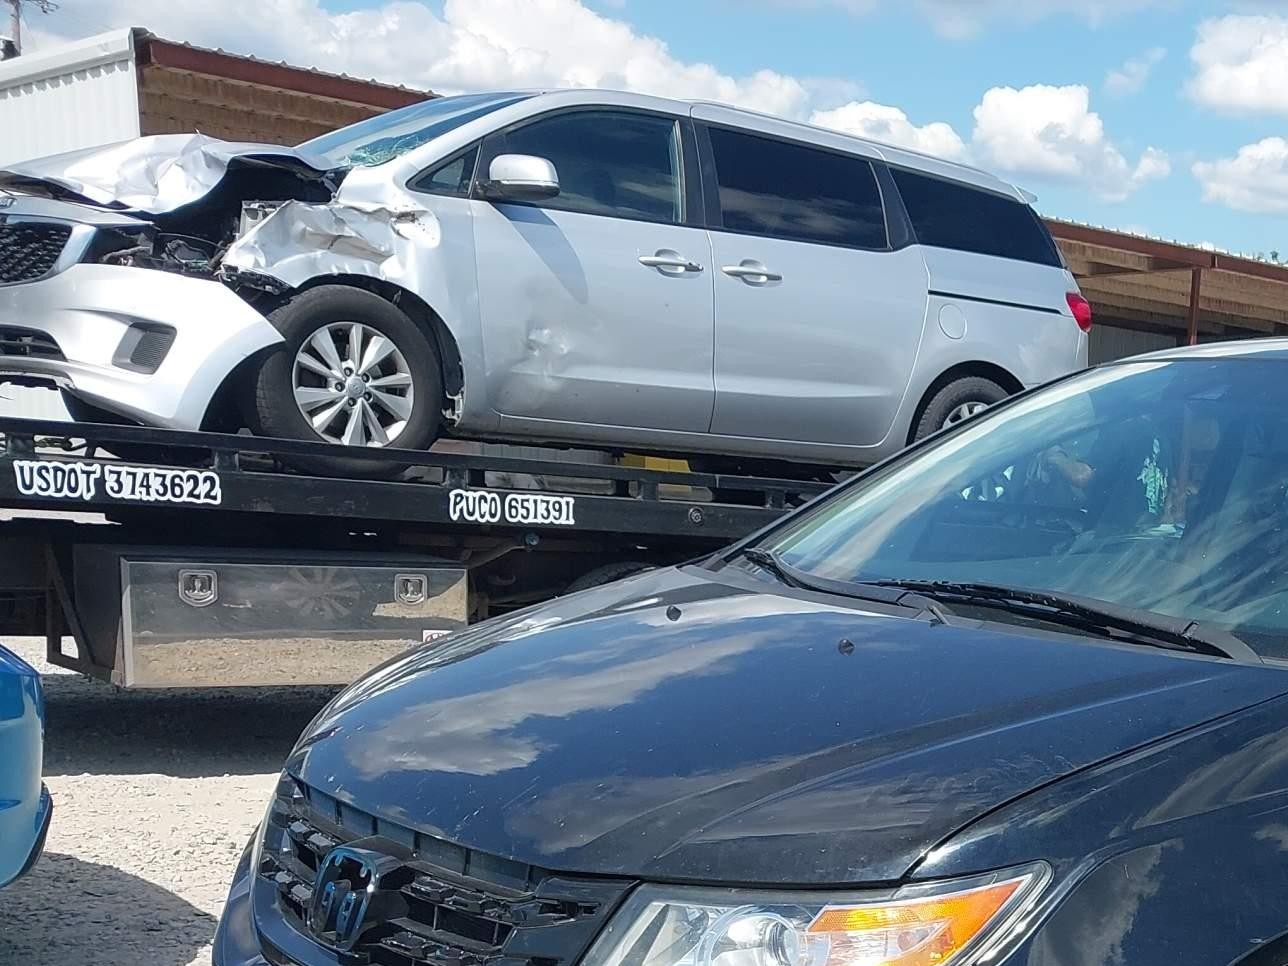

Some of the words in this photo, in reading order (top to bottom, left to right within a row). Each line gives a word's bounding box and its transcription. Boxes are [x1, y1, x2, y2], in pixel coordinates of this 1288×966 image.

[15, 462, 99, 499] USDOT
[105, 466, 221, 504] 3743622
[449, 489, 500, 523] PUCO
[505, 494, 575, 524] 651391
